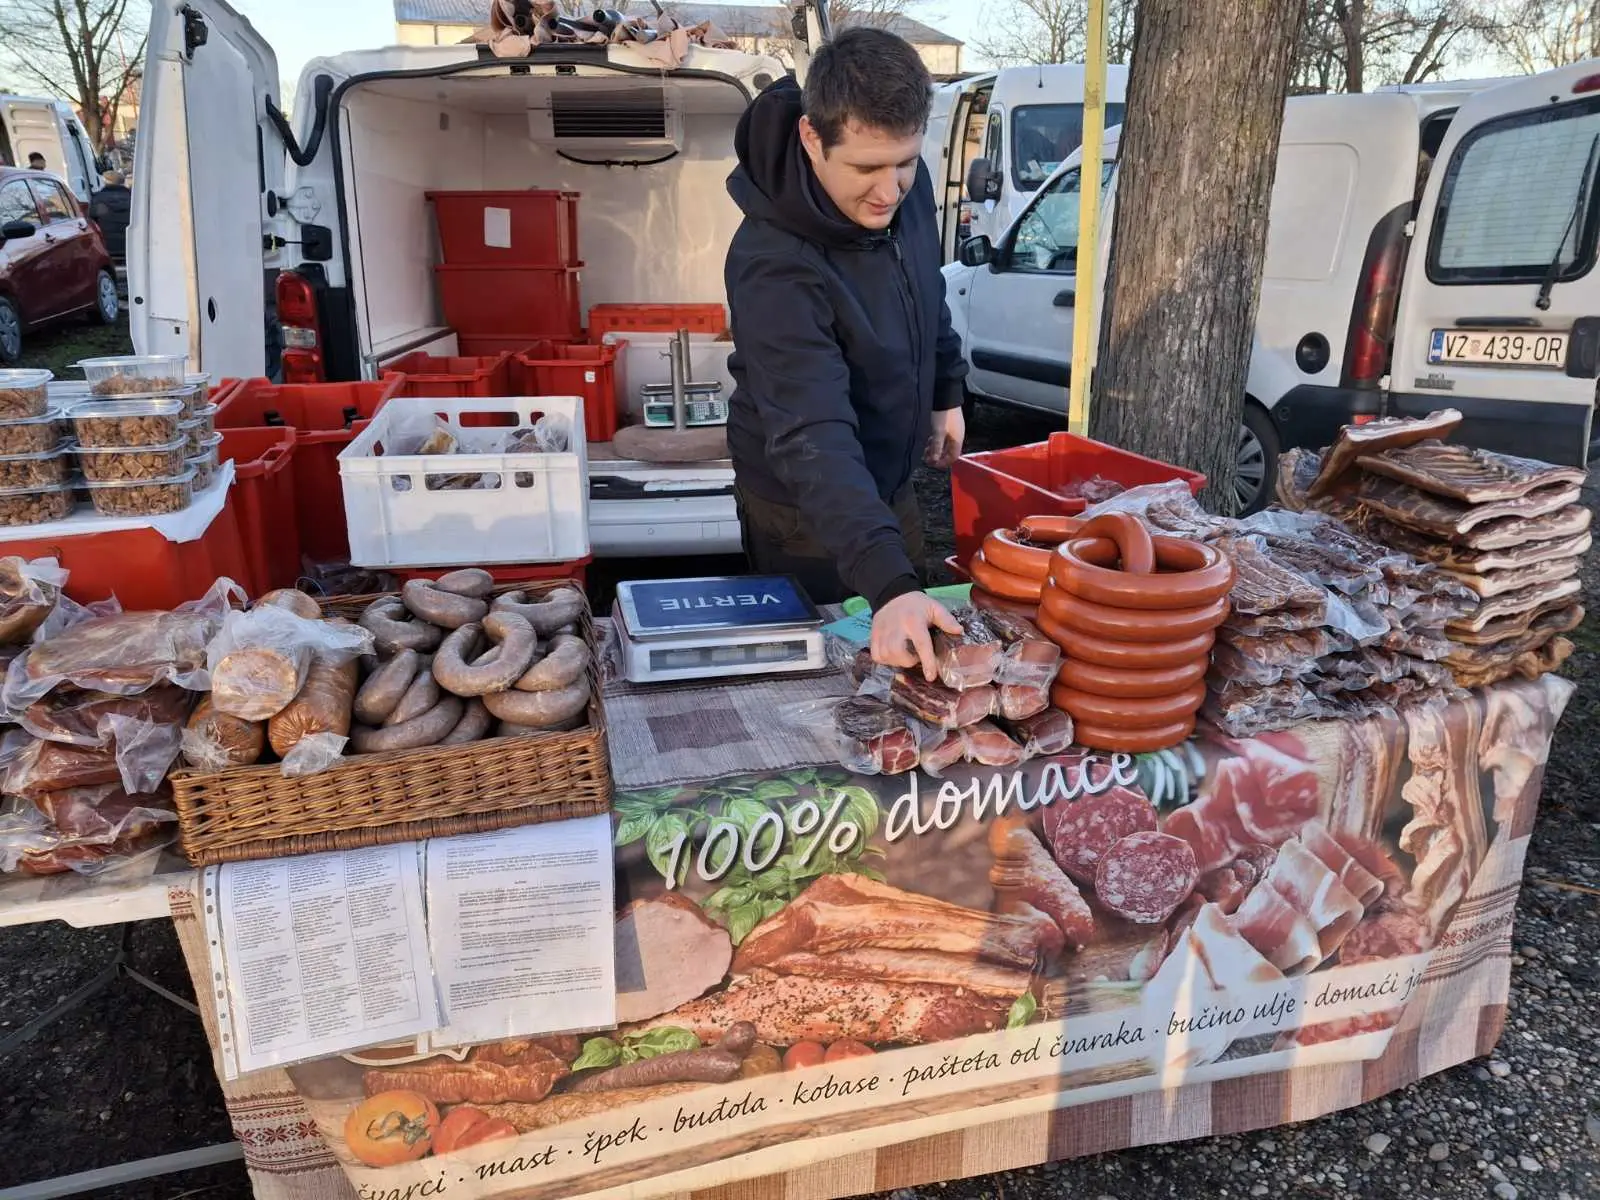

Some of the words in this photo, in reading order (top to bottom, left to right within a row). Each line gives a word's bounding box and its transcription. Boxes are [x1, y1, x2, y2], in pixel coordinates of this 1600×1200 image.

[1446, 335, 1468, 357] VZ
[1483, 336, 1562, 362] 439-OR
[659, 594, 782, 611] VERTIE
[656, 793, 859, 890] 100%
[475, 1145, 556, 1180] mast
[583, 1117, 648, 1164] špek
[673, 1091, 768, 1133] buđola
[792, 1074, 880, 1105] kobase
[902, 1055, 1002, 1096] pašteta
[1010, 1037, 1041, 1064] od
[1049, 1020, 1146, 1056] čvaraka
[1167, 1004, 1246, 1036] bučino
[1253, 992, 1297, 1027] ulje
[1314, 972, 1399, 1008] domaći
